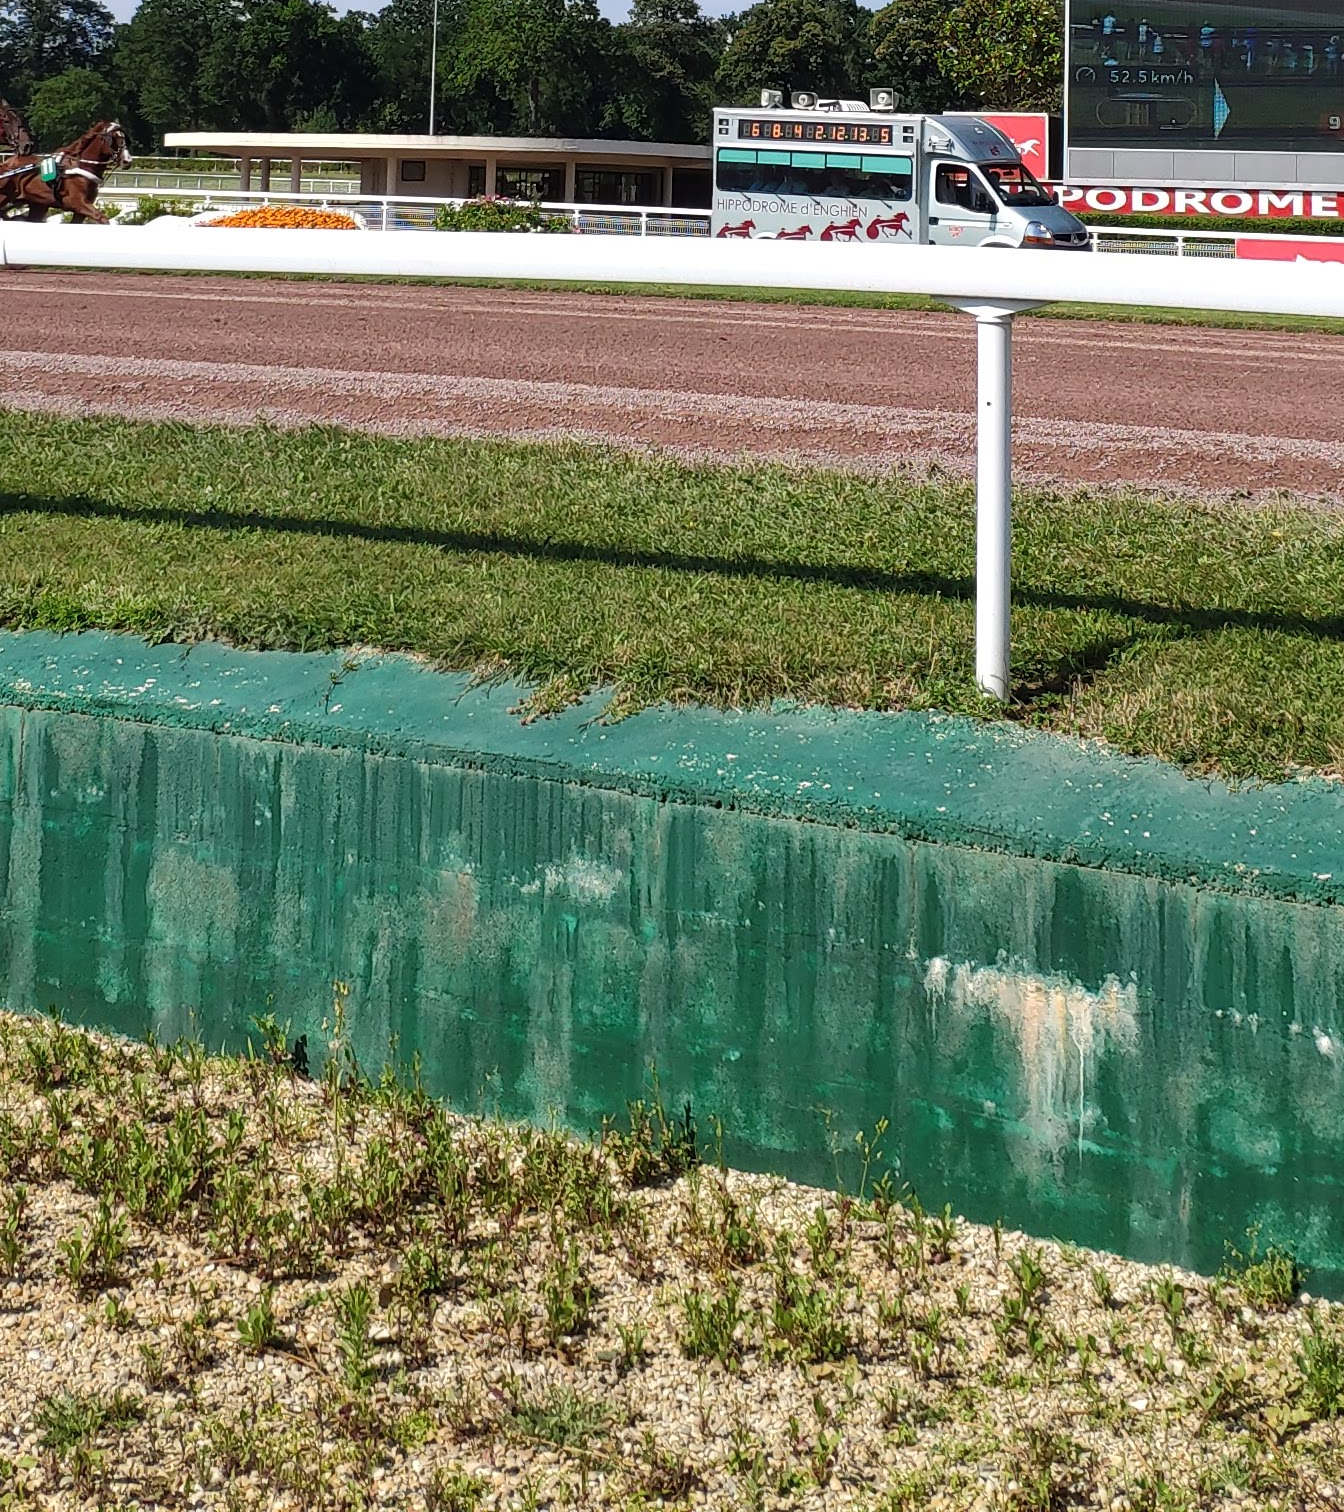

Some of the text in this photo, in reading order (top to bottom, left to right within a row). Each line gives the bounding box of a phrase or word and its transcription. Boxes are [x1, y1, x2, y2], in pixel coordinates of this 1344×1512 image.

[1328, 115, 1341, 130] 9
[41, 158, 54, 174] 11
[717, 198, 868, 218] HIPPODROME d'ENGHIEN
